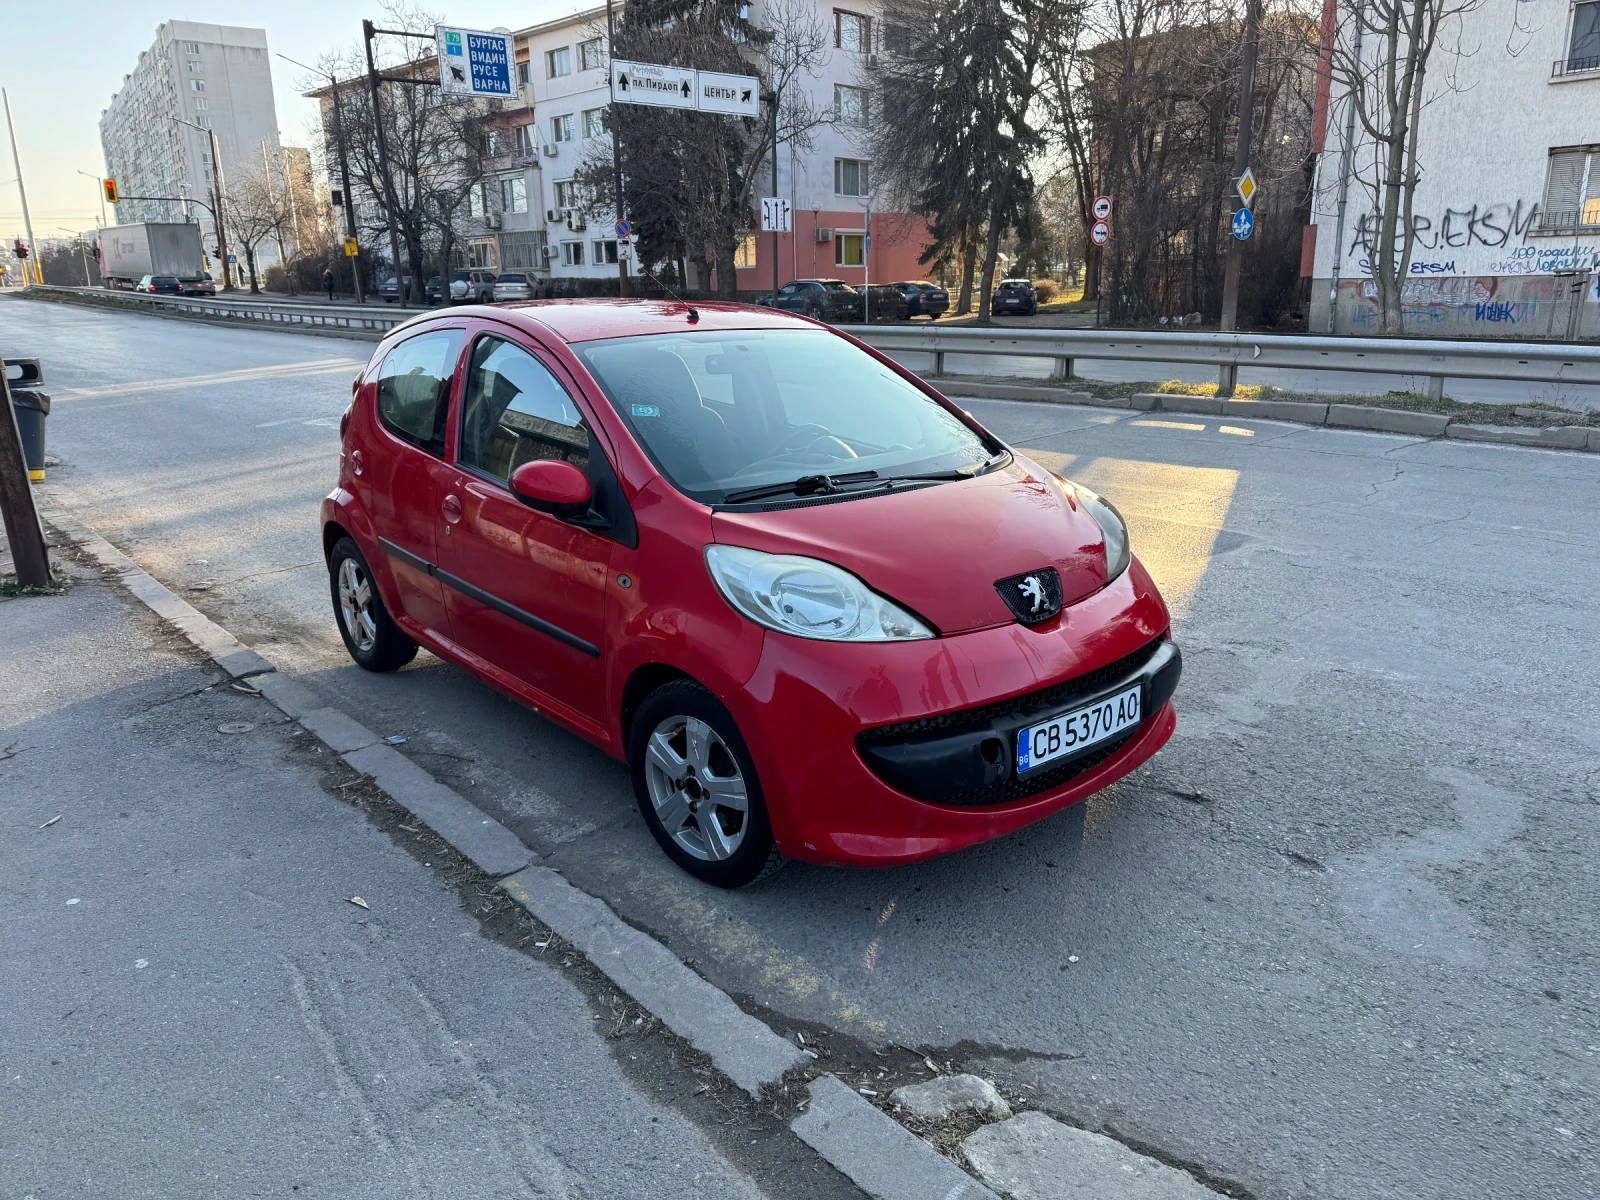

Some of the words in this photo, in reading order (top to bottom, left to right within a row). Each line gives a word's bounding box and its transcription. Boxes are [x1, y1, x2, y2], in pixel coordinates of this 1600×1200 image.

[446, 33, 451, 42] E
[452, 33, 460, 43] 79
[469, 36, 504, 51] БУРГАС
[471, 51, 506, 65] ВИДИН
[473, 64, 499, 77] РУСЕ
[474, 78, 508, 91] ВАРНА
[632, 79, 645, 88] пл.
[646, 78, 678, 92] Пирдоп
[704, 86, 736, 99] ЦЕНТЪР
[1033, 723, 1061, 759] CB
[1065, 703, 1113, 747] 5370
[1116, 692, 1137, 727] AO
[1018, 755, 1029, 766] BG
